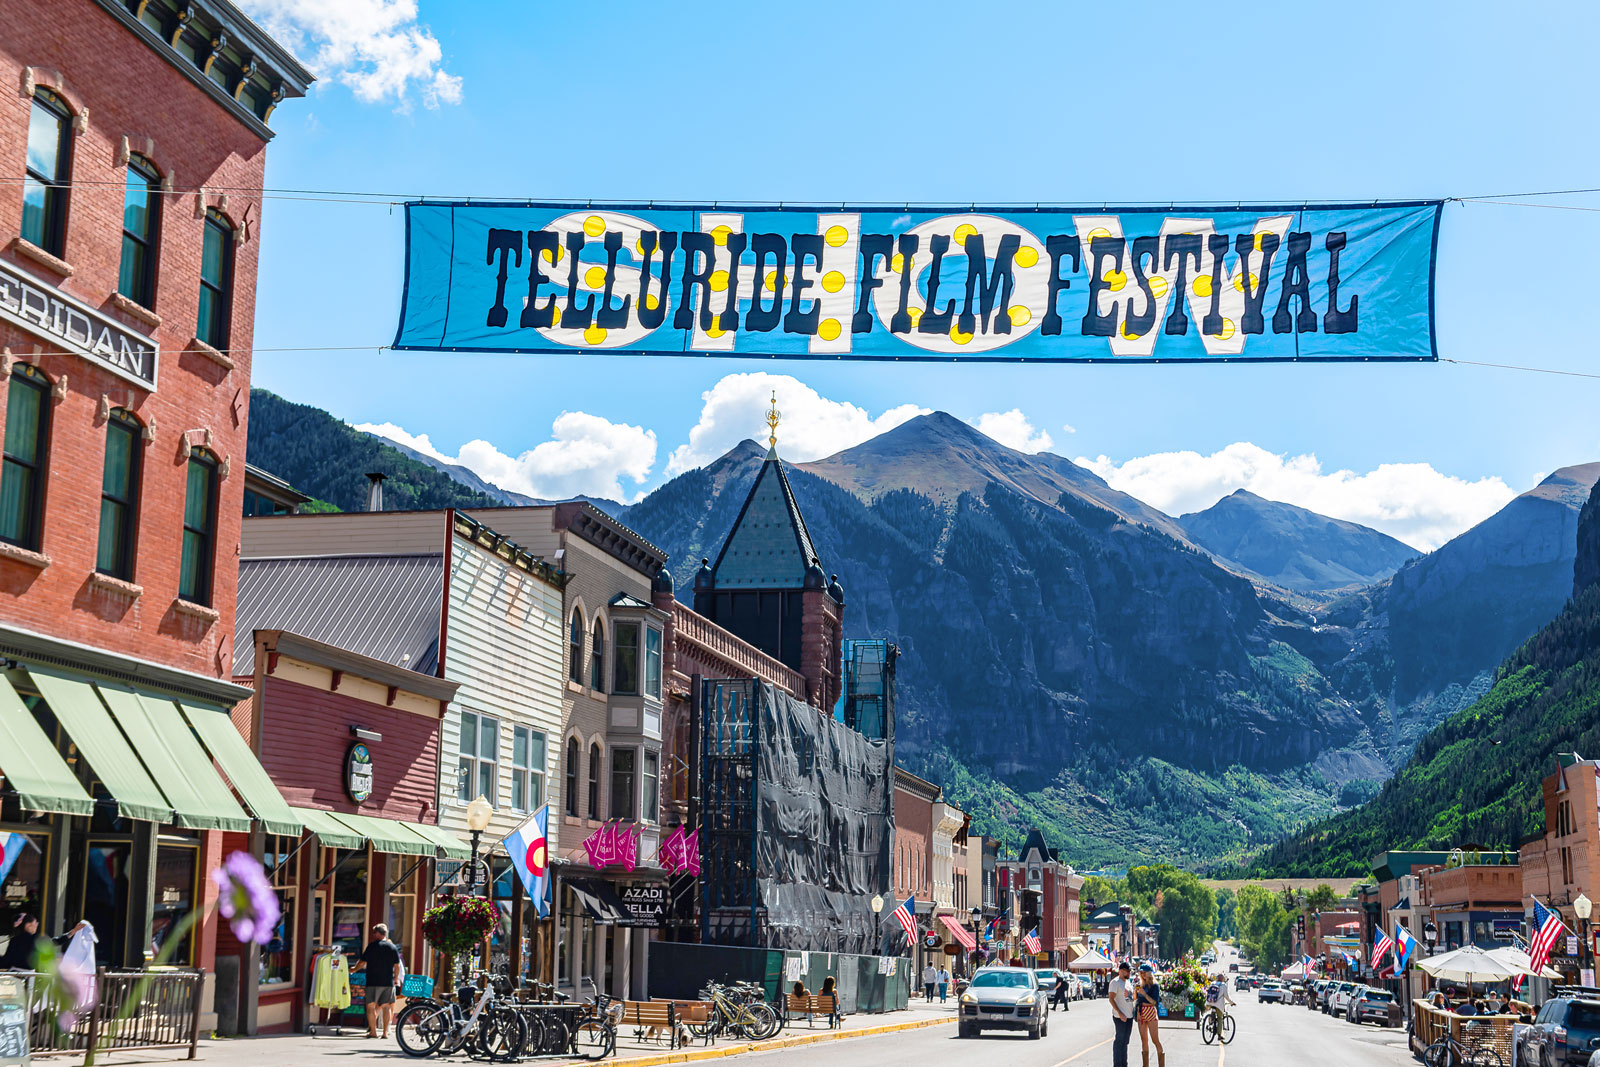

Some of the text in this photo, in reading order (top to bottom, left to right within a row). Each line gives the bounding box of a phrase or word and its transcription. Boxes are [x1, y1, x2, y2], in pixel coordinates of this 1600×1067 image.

[486, 228, 1359, 336] TELLURIDE FILM FESTIVAL
[464, 874, 486, 882] OUSIDE
[624, 888, 662, 898] AZADI
